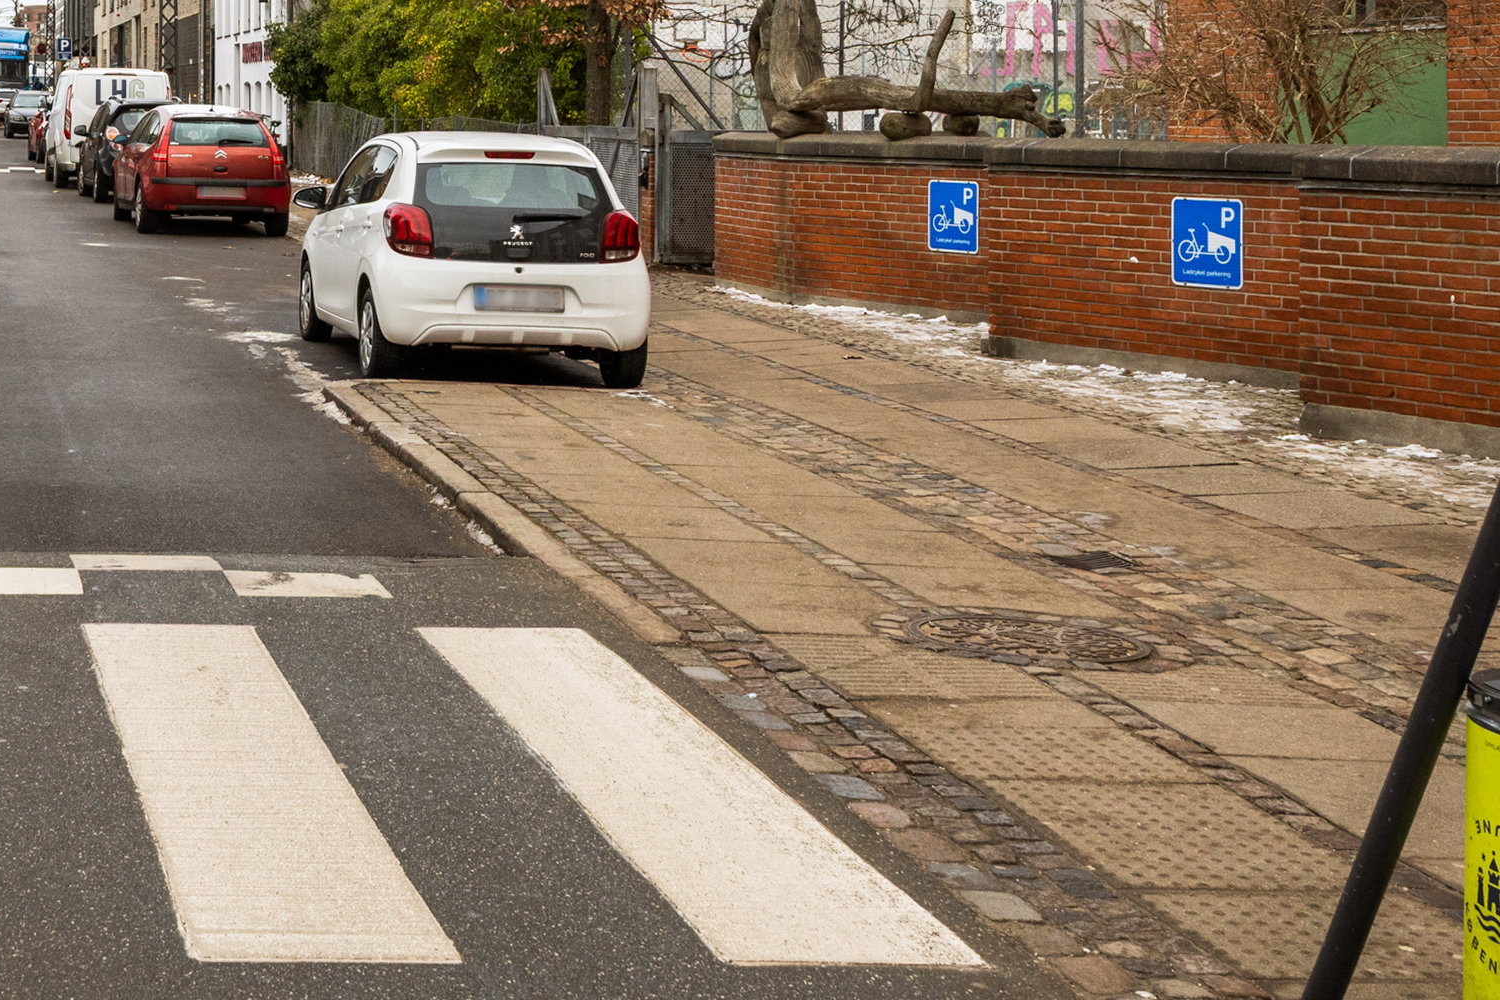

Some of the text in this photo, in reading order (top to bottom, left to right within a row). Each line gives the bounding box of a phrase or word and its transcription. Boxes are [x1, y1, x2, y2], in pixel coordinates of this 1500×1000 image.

[61, 40, 70, 51] P
[95, 79, 145, 105] LHG
[963, 187, 973, 205] P
[1220, 207, 1235, 228] P
